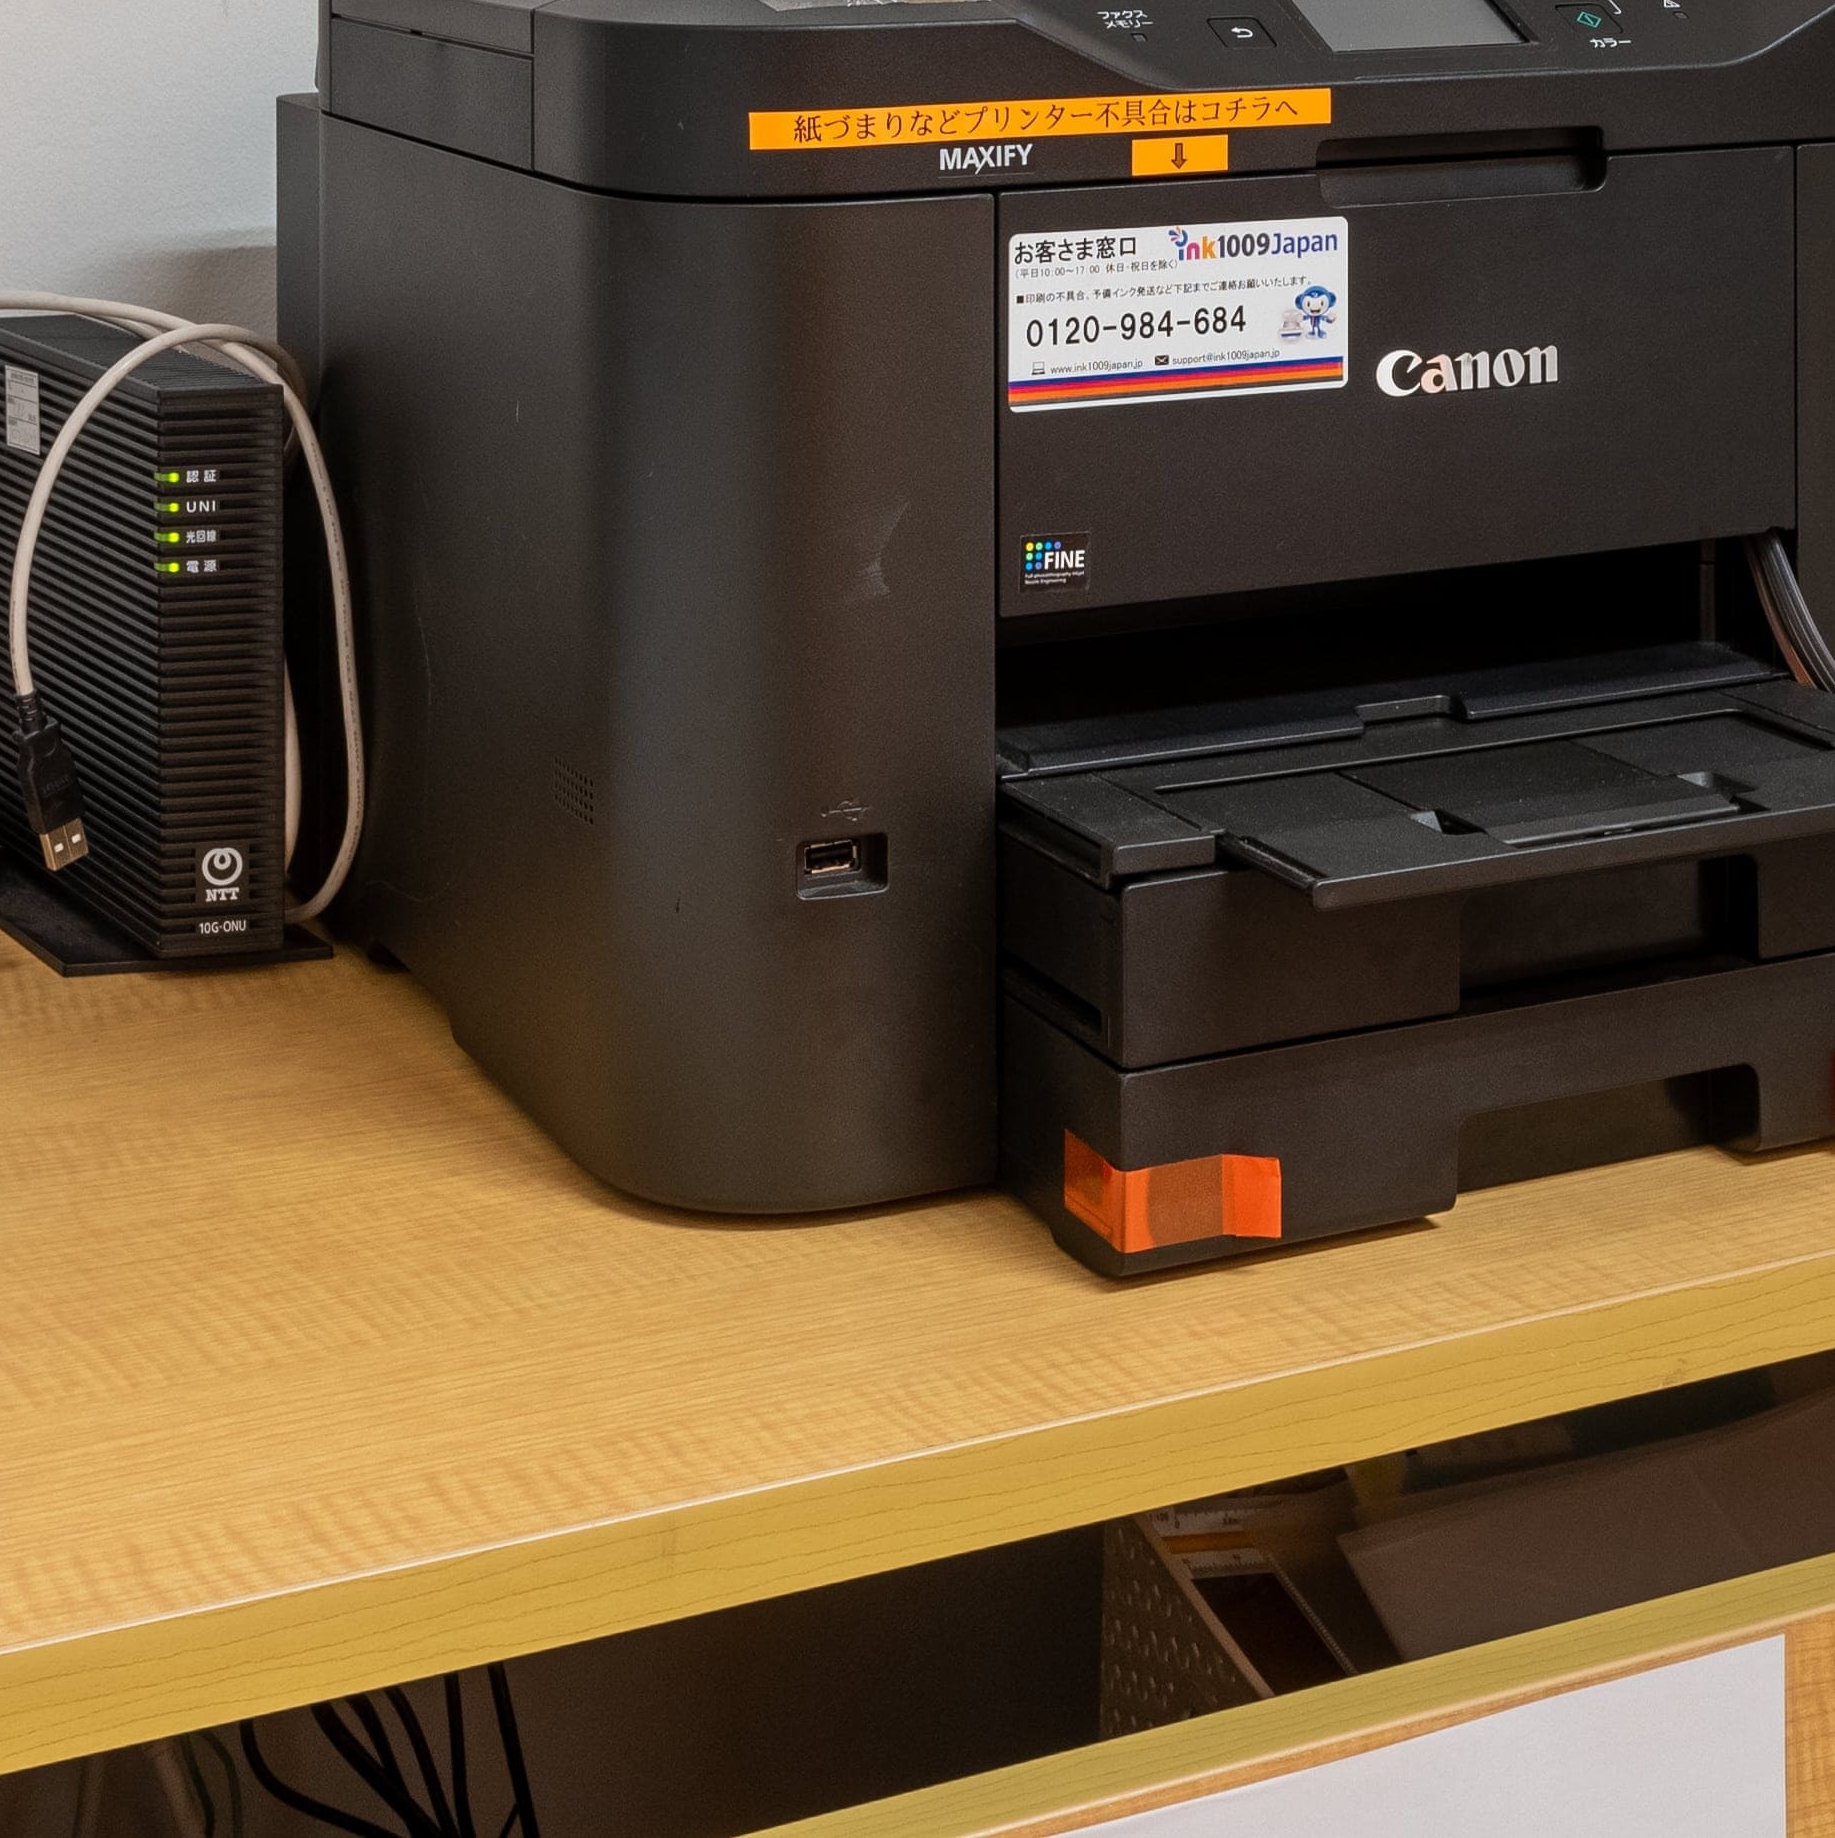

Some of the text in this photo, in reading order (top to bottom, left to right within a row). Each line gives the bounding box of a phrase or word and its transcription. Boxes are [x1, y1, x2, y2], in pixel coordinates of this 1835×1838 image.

[1097, 10, 1148, 19] ファクス
[1104, 19, 1154, 29] メモリー
[1589, 38, 1632, 49] カラー
[793, 98, 1298, 143] 紙づまりなどプリンター不具合はコチラへ
[939, 144, 1033, 175] MAXIFY
[1014, 235, 1137, 264] お客さま窓口
[1026, 305, 1246, 348] 0120-984-684
[1050, 348, 1281, 375] www.ink1009japan.jp support@ink1009japan.jp
[1376, 345, 1559, 397] Canon
[186, 469, 217, 483] 認証
[186, 500, 216, 513] UNI
[186, 529, 217, 543] 光回線
[186, 559, 217, 573] 電源
[1044, 550, 1085, 570] FINE
[205, 887, 240, 902] NTT
[199, 920, 247, 935] 10G-ONU
